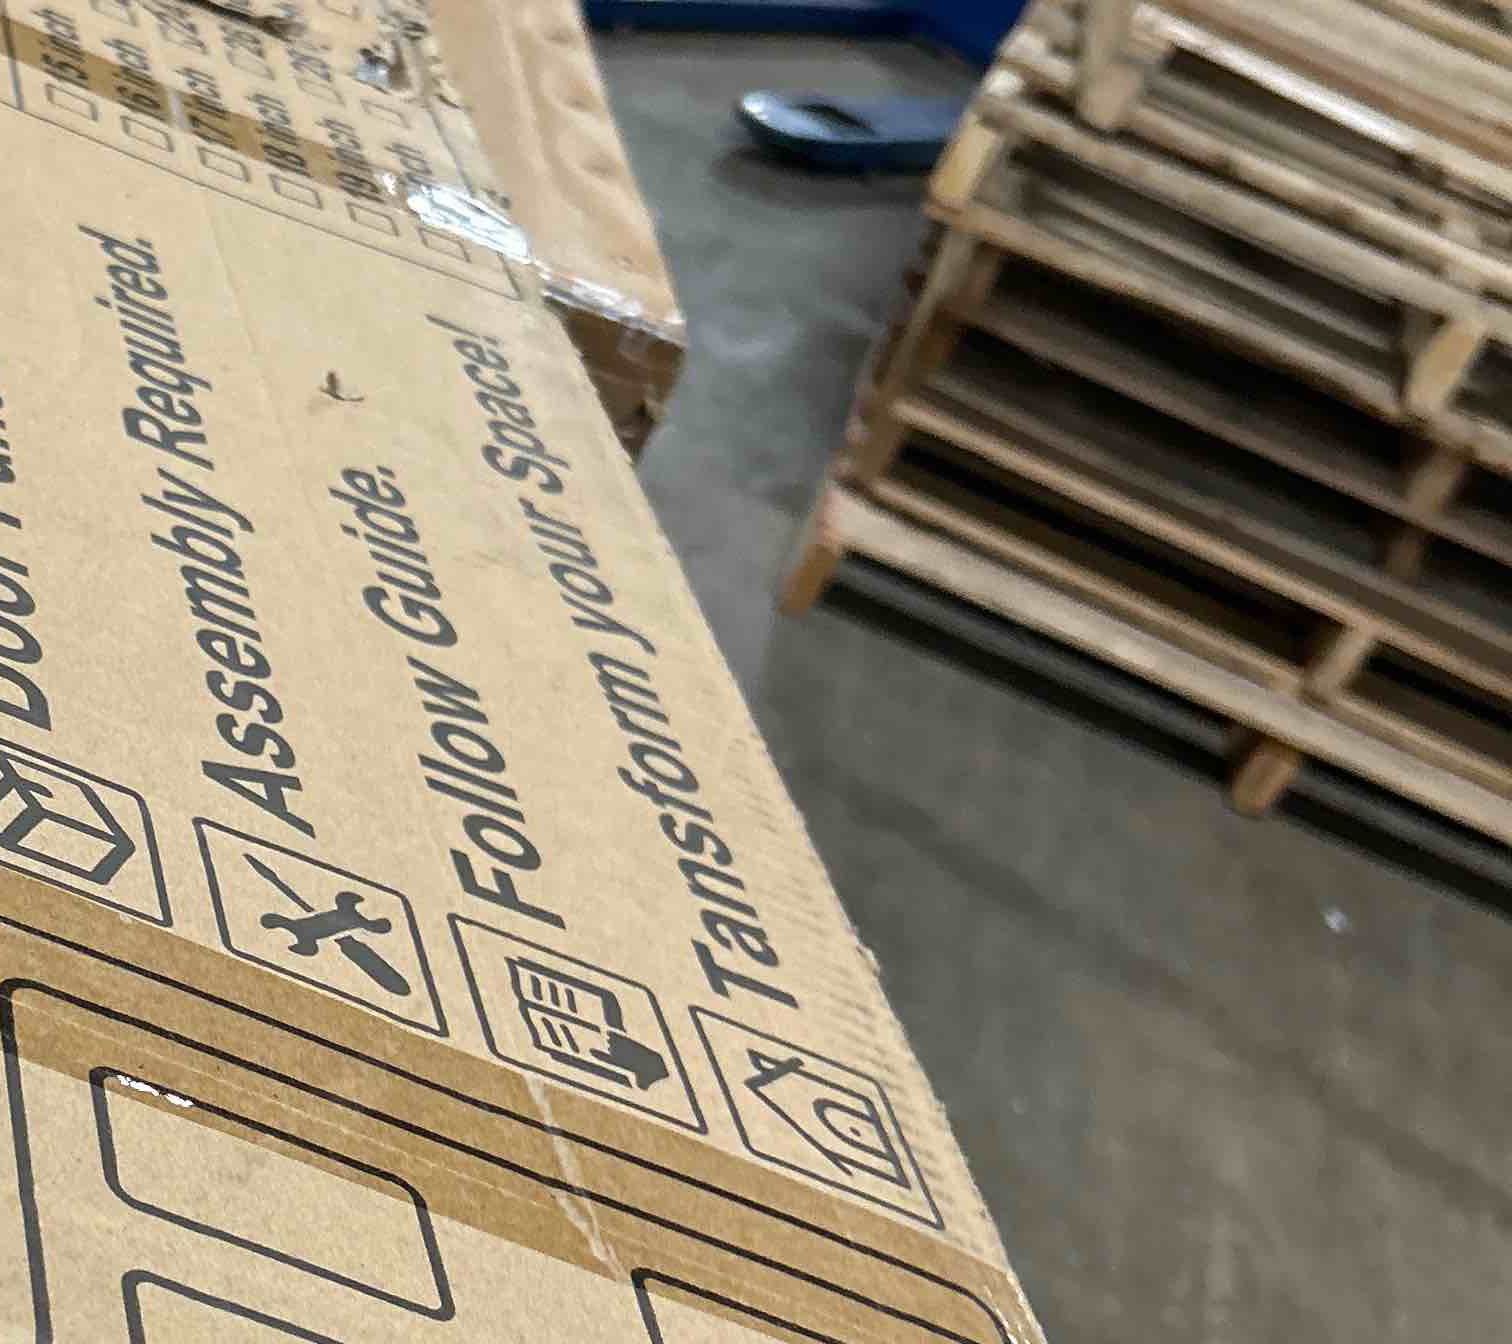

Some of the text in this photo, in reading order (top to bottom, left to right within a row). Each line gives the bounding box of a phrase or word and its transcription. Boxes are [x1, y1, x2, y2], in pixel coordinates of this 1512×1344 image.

[77, 223, 317, 841] Assembly Required.
[328, 464, 567, 930] Follow Guide.
[425, 314, 800, 1011] Tansform your Space!
